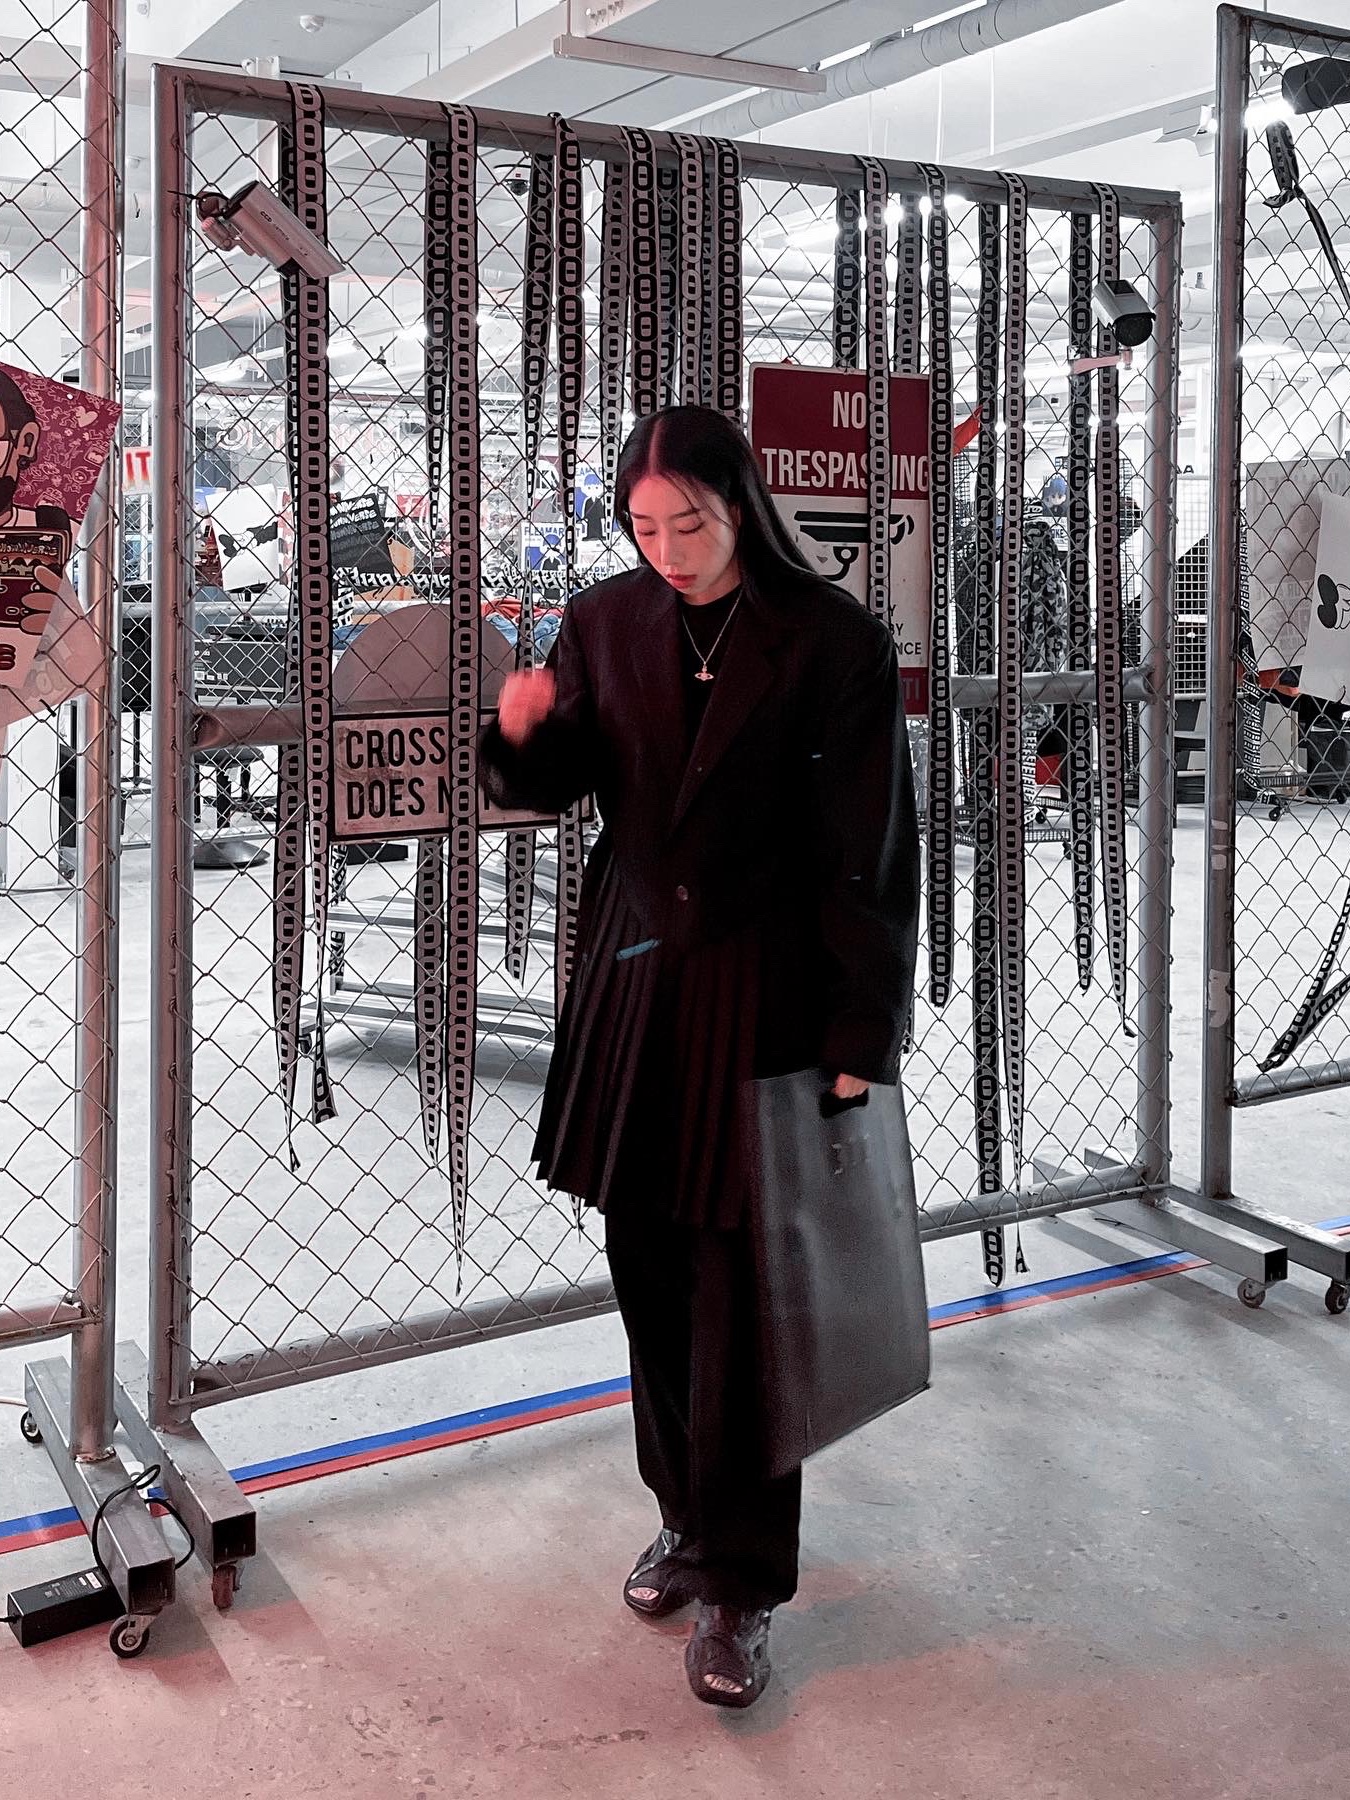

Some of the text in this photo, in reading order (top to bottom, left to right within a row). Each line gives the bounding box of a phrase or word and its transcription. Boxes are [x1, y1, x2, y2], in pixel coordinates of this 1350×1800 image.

[832, 390, 867, 430] NO
[761, 447, 930, 493] TRESPASING
[524, 526, 580, 536] FLEAMART
[894, 641, 922, 656] NCE
[345, 726, 447, 770] CROSS
[346, 776, 426, 820] DOES
